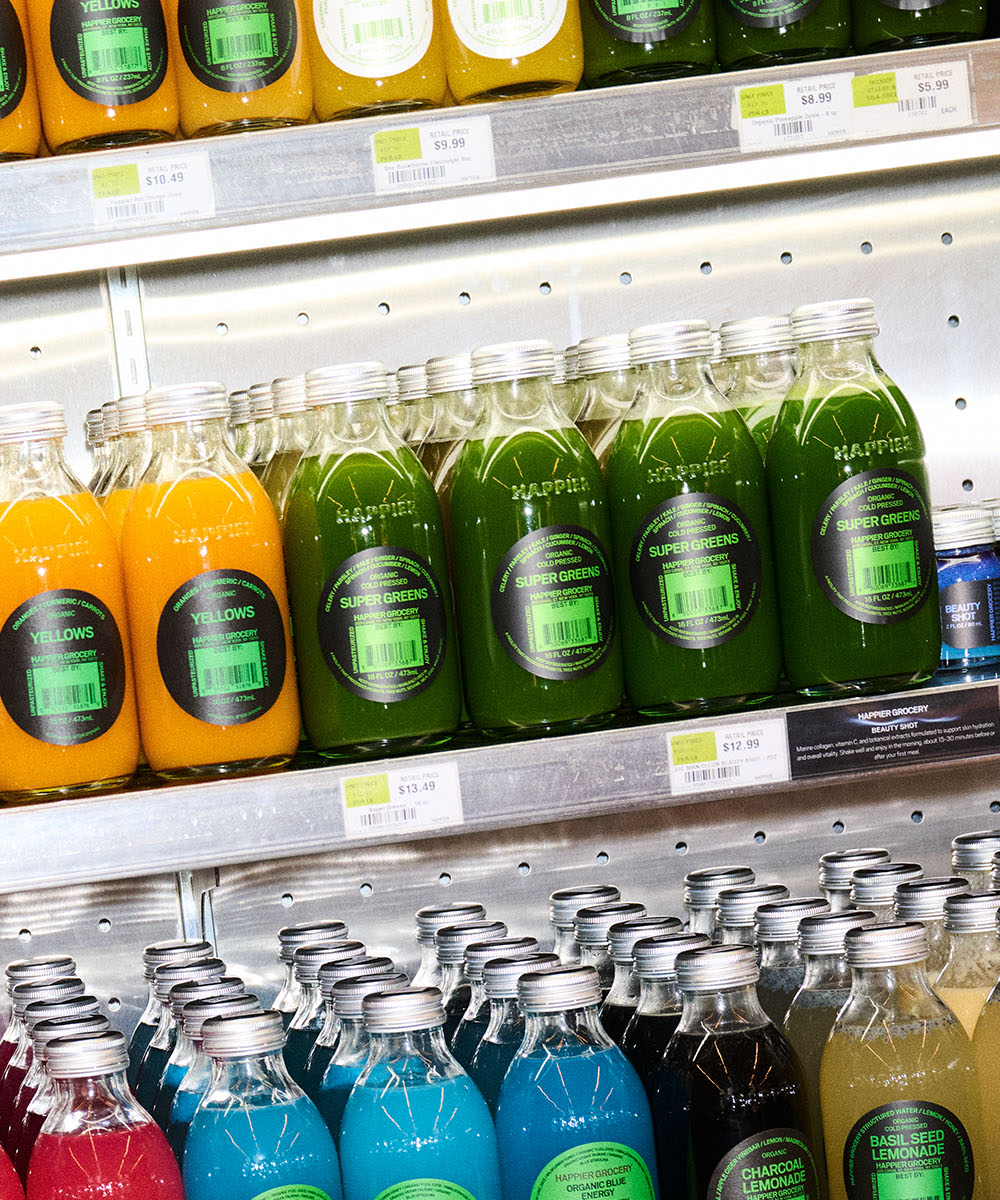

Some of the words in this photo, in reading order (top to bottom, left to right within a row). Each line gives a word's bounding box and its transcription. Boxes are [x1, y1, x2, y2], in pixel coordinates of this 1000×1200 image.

[80, 0, 140, 13] YELLOWS
[918, 80, 949, 92] $5.99
[800, 92, 832, 105] $8.99
[434, 137, 466, 150] $9.99
[145, 172, 184, 186] $10.49
[837, 515, 879, 532] SUPER
[881, 510, 921, 527] GREENS
[851, 533, 882, 543] HAPPIER
[883, 529, 912, 540] GROCERY
[545, 550, 573, 559] ORGANIC
[515, 572, 557, 589] SUPER
[559, 566, 600, 582] GREENS
[339, 594, 382, 609] SUPER
[384, 588, 428, 604] GREENS
[945, 602, 981, 613] BEAUTY
[191, 606, 255, 625] YELLOWS
[951, 611, 976, 622] SHOT
[858, 710, 892, 720] HAPPIER
[892, 705, 928, 716] GROCERY
[872, 725, 898, 734] BEAUTY
[900, 722, 918, 730] SHOT
[723, 738, 759, 752] $12.99
[398, 781, 436, 795] $13.49
[901, 1123, 928, 1131] PRESSED
[870, 1133, 911, 1147] BASIL
[913, 1130, 945, 1142] SEED
[872, 1143, 945, 1160] LEMONADE
[742, 1158, 804, 1181] CHARCOAL
[876, 1161, 907, 1169] HAPPIER
[908, 1157, 941, 1166] GROCERY
[556, 1170, 594, 1182] HAPPIER
[596, 1164, 632, 1178] GROCERY
[566, 1180, 604, 1192] ORGANIC
[606, 1177, 626, 1186] BLUE
[743, 1170, 806, 1194] LEMONADE
[582, 1188, 615, 1200] ENERGY
